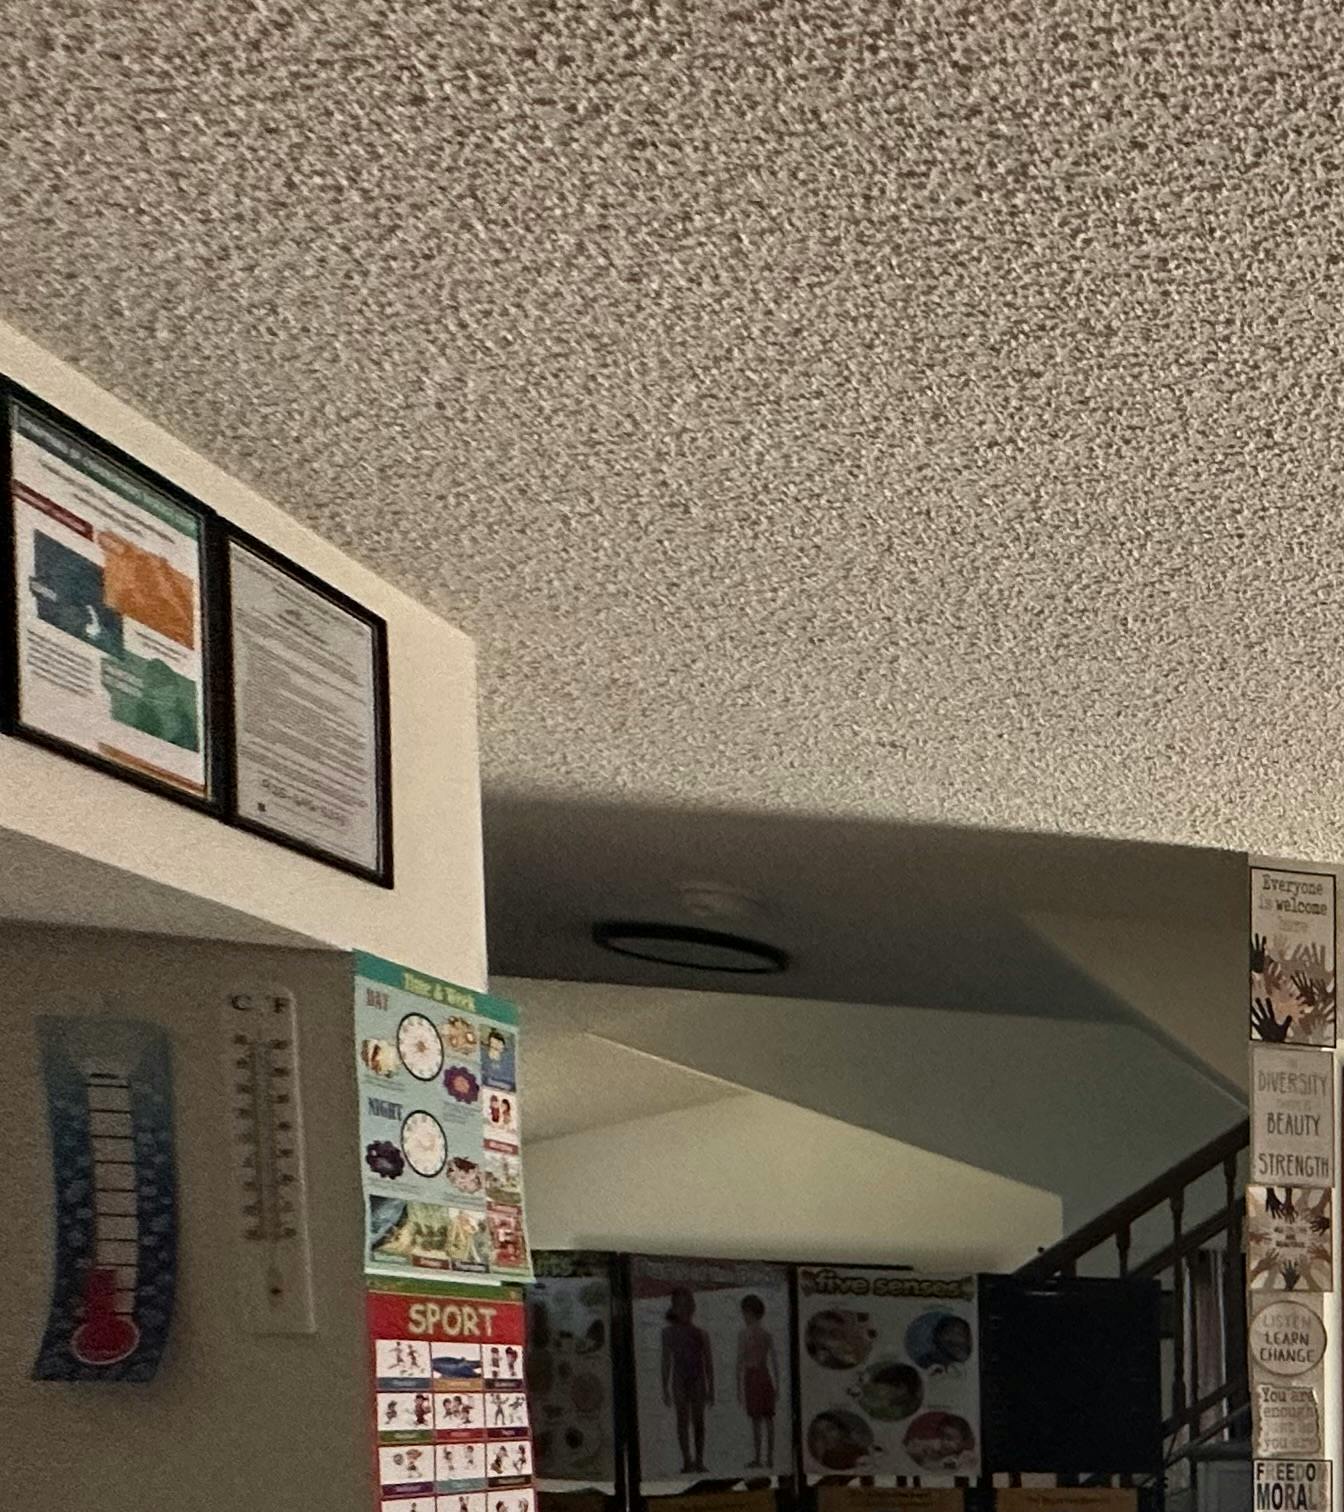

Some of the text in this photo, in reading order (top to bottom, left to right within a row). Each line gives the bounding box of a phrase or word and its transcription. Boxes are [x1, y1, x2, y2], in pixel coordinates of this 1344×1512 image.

[1262, 874, 1323, 895] Everyone
[1275, 897, 1327, 916] welcome
[367, 988, 389, 1012] DAY
[1258, 1070, 1328, 1096] DIVERSITY
[367, 1098, 402, 1121] NIGHT
[1267, 1112, 1321, 1137] BEAUTY
[1258, 1153, 1329, 1178] STRENGTH
[814, 1270, 869, 1295] five
[872, 1275, 960, 1297] senses
[407, 1303, 497, 1338] SPORT
[1264, 1332, 1309, 1346] LEARN
[1259, 1348, 1314, 1363] CHANGE
[1261, 1388, 1287, 1402] You
[1257, 1462, 1327, 1482] FREEDOM
